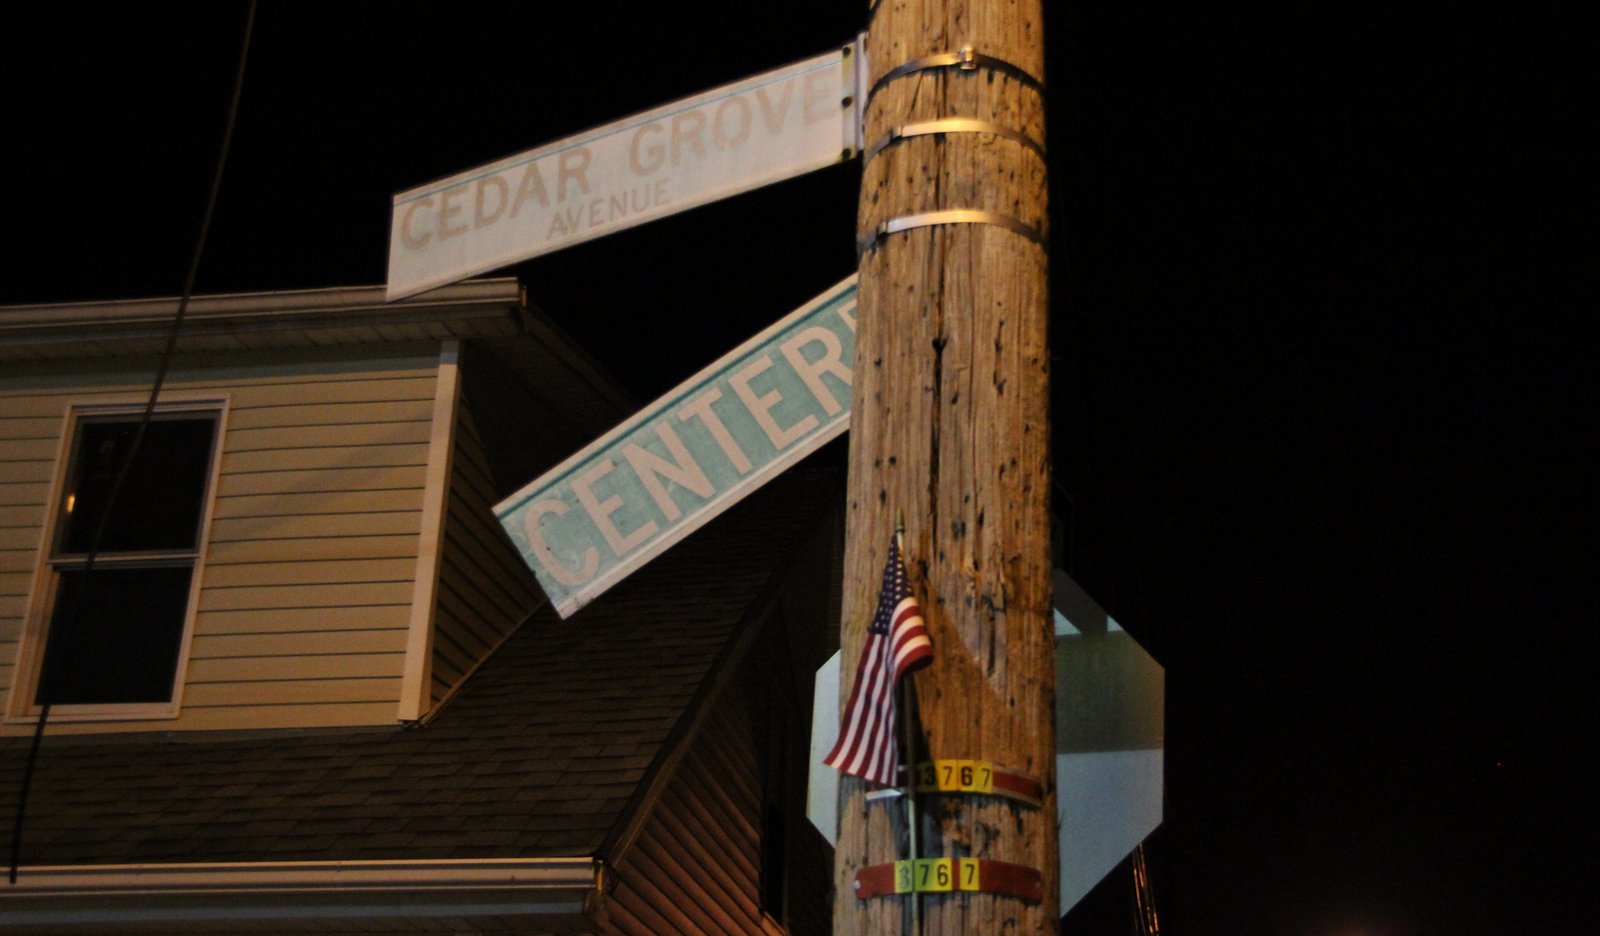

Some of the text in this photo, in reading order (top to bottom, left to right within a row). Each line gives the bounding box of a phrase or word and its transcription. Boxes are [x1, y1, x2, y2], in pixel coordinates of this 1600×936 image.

[402, 68, 839, 251] CEDAR GROVE
[546, 177, 673, 241] AVENUE
[523, 300, 858, 586] CENTER
[924, 765, 991, 788] 3767
